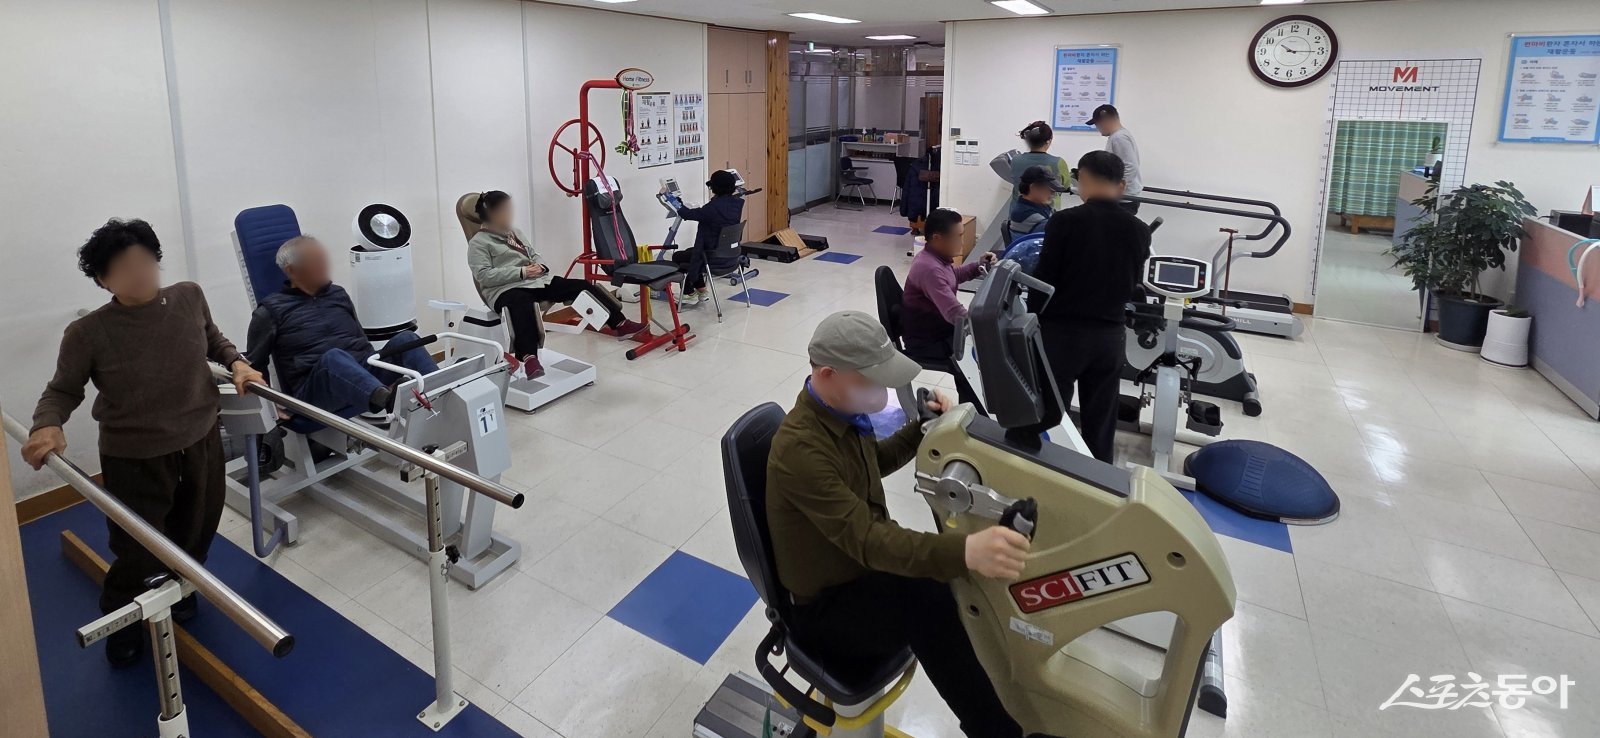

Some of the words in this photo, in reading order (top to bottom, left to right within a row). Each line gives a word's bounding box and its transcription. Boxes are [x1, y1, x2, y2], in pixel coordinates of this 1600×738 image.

[1277, 28, 1284, 36] 11
[1290, 24, 1299, 33] 12
[1306, 27, 1310, 36] 1
[1266, 37, 1274, 45] 10
[1314, 35, 1321, 44] 2
[1260, 48, 1266, 56] 9
[1317, 46, 1325, 56] 3
[1263, 59, 1270, 67] 8
[1273, 67, 1280, 75] 7
[1286, 69, 1293, 78] 6
[1299, 67, 1307, 75] 5
[1020, 560, 1133, 606] SCIFIT
